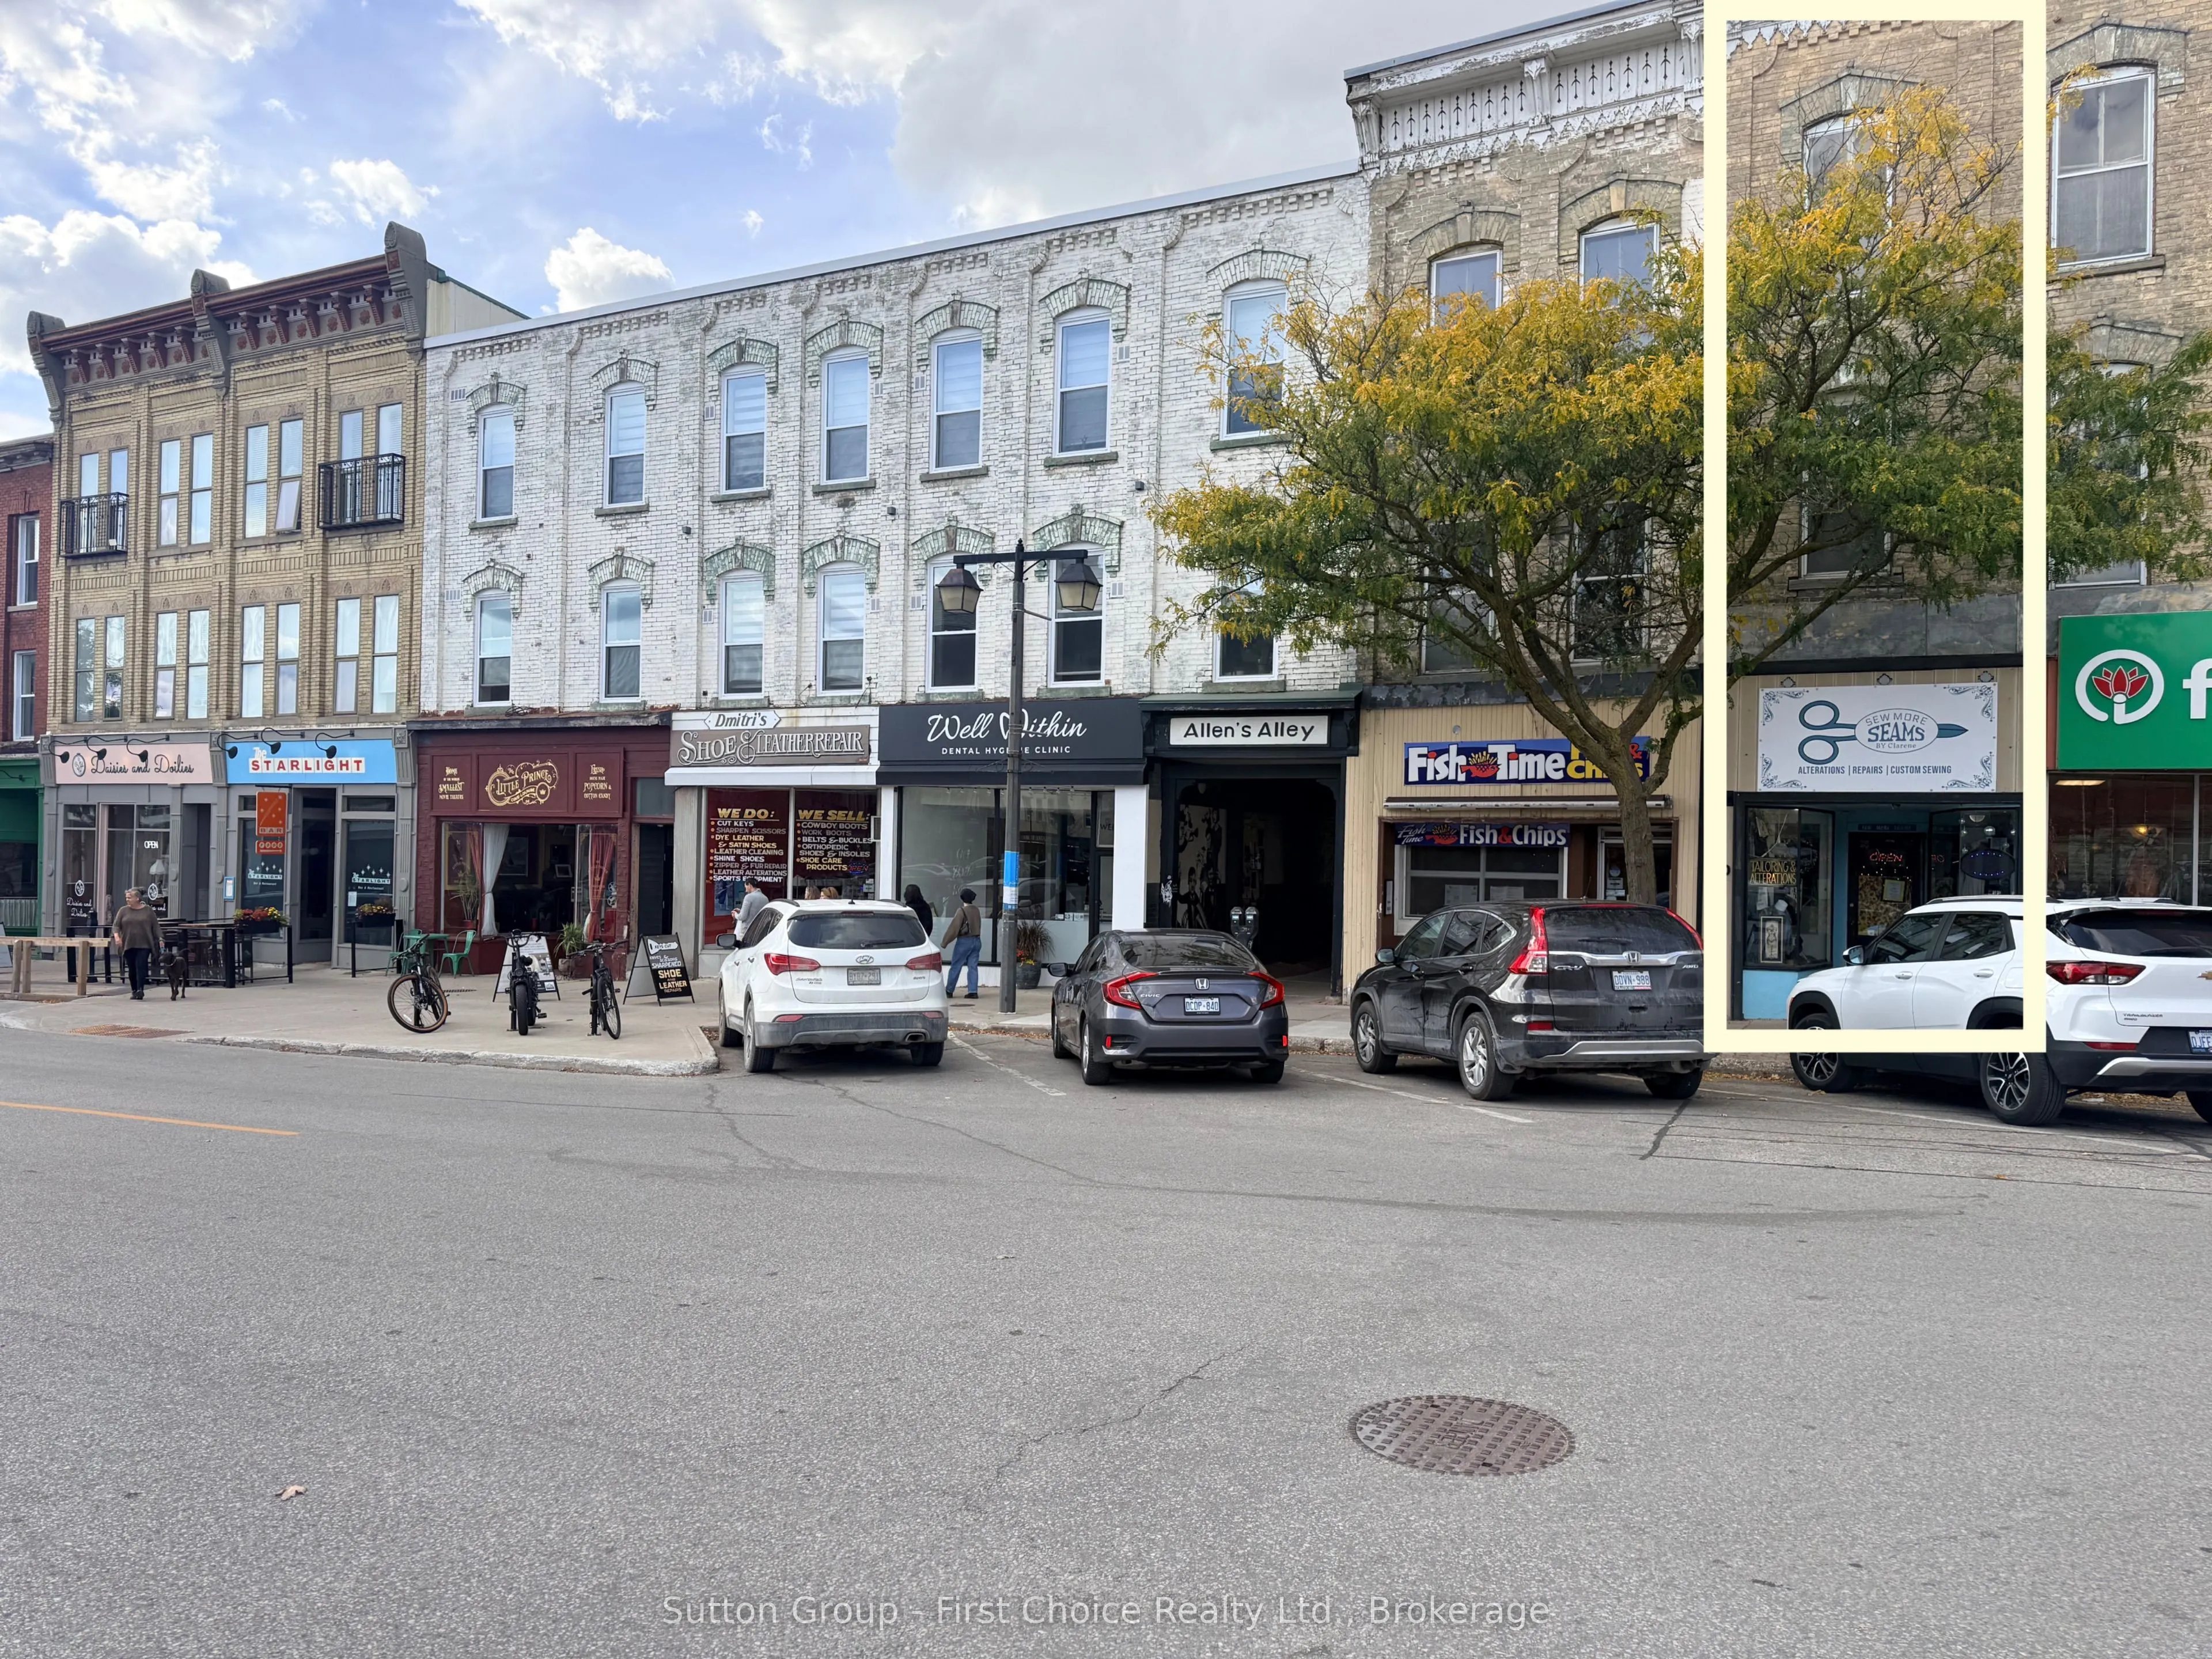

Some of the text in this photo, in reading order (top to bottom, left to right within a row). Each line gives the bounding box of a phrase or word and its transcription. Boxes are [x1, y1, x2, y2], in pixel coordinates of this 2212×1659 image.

[714, 712, 767, 727] Dmitri's
[1866, 713, 1927, 726] SEW MORE
[927, 713, 994, 742] Well
[1183, 722, 1315, 741] Allen's Alley
[1868, 722, 1925, 742] SEAMS
[253, 747, 266, 759] The
[677, 729, 865, 766] SHOE & LEATHER REPAIR
[91, 754, 194, 774] Daisies and Doilies
[251, 760, 362, 771] STARLIGHT
[1408, 744, 1467, 782] Fish
[1487, 744, 1566, 780] Time
[445, 767, 458, 776] HOME
[1567, 760, 1643, 779] Chs
[1798, 766, 1952, 774] ALTERATIONS REPAIRS CUSTOM SEWING
[438, 781, 465, 793] SMALLEST
[496, 770, 552, 796] LITTLE PRINCE
[583, 782, 608, 792] POPCORN
[717, 808, 741, 818] WE
[798, 810, 824, 820] WE
[1398, 824, 1425, 838] Fish
[1460, 824, 1498, 844] Fish
[1512, 824, 1566, 846] Chips
[1402, 835, 1424, 845] Time
[1870, 853, 1903, 862] OPEN
[1751, 861, 1796, 873] TAILORING &
[1749, 873, 1796, 884] ALTERATIONS
[652, 961, 681, 969] SHARPENED
[658, 968, 682, 979] SHOE
[659, 980, 688, 990] LEATHER
[1614, 975, 1650, 985] DDVN 988
